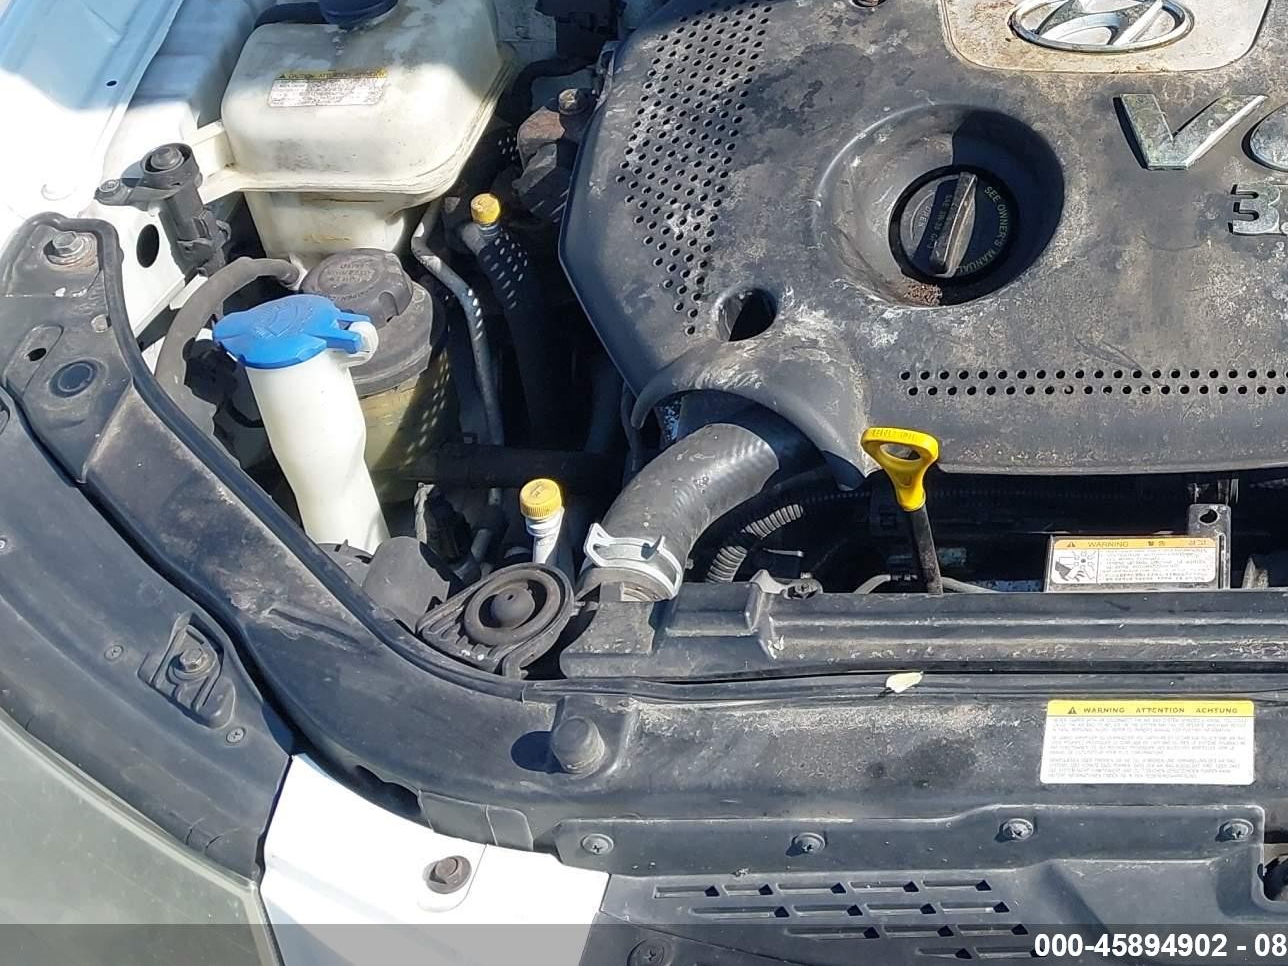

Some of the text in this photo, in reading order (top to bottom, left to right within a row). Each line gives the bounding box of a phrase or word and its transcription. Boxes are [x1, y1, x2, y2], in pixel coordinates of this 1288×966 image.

[959, 186, 1010, 273] SEE OWNER'S MANUAL
